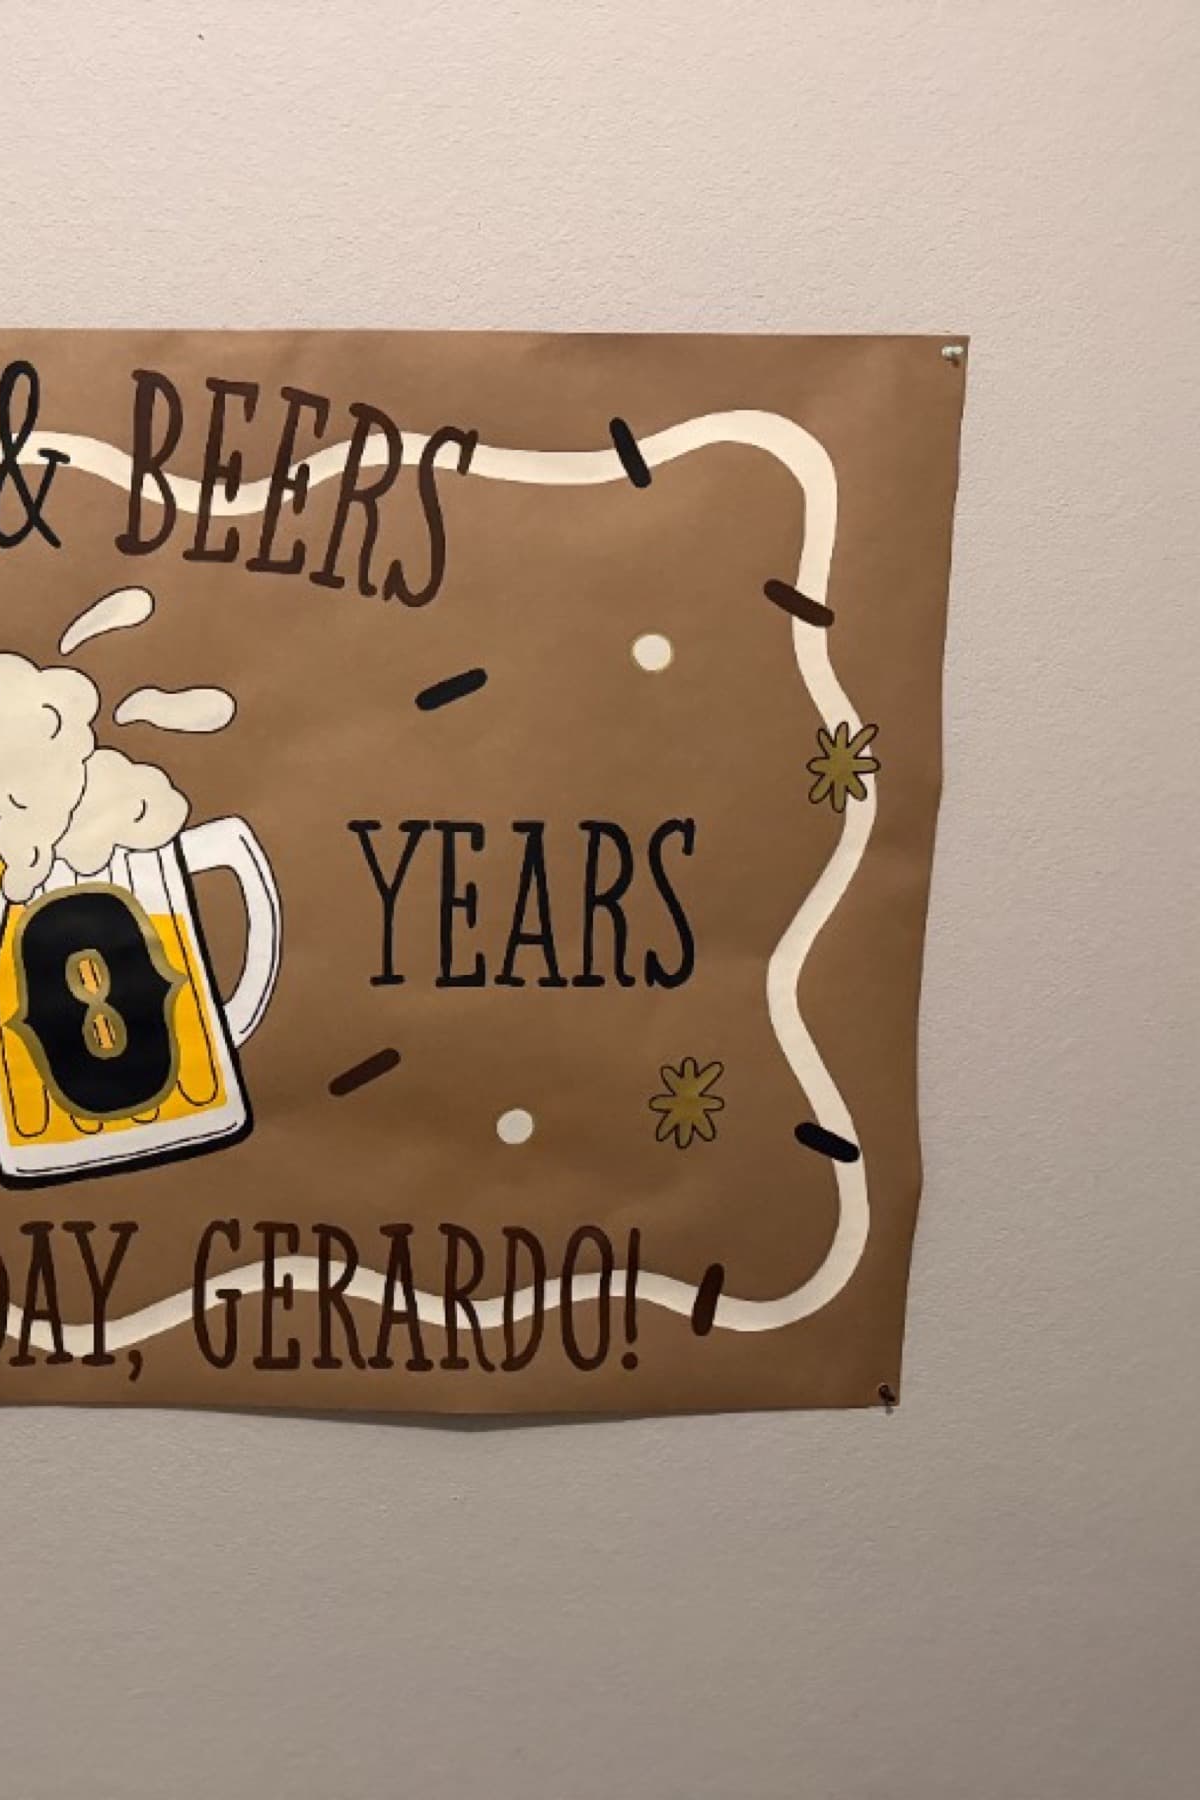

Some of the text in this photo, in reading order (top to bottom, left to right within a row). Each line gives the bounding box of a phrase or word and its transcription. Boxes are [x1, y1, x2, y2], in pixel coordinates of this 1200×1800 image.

[114, 369, 479, 608] BEERS
[347, 818, 696, 989] YEARS
[193, 1218, 640, 1372] GERARDO!
